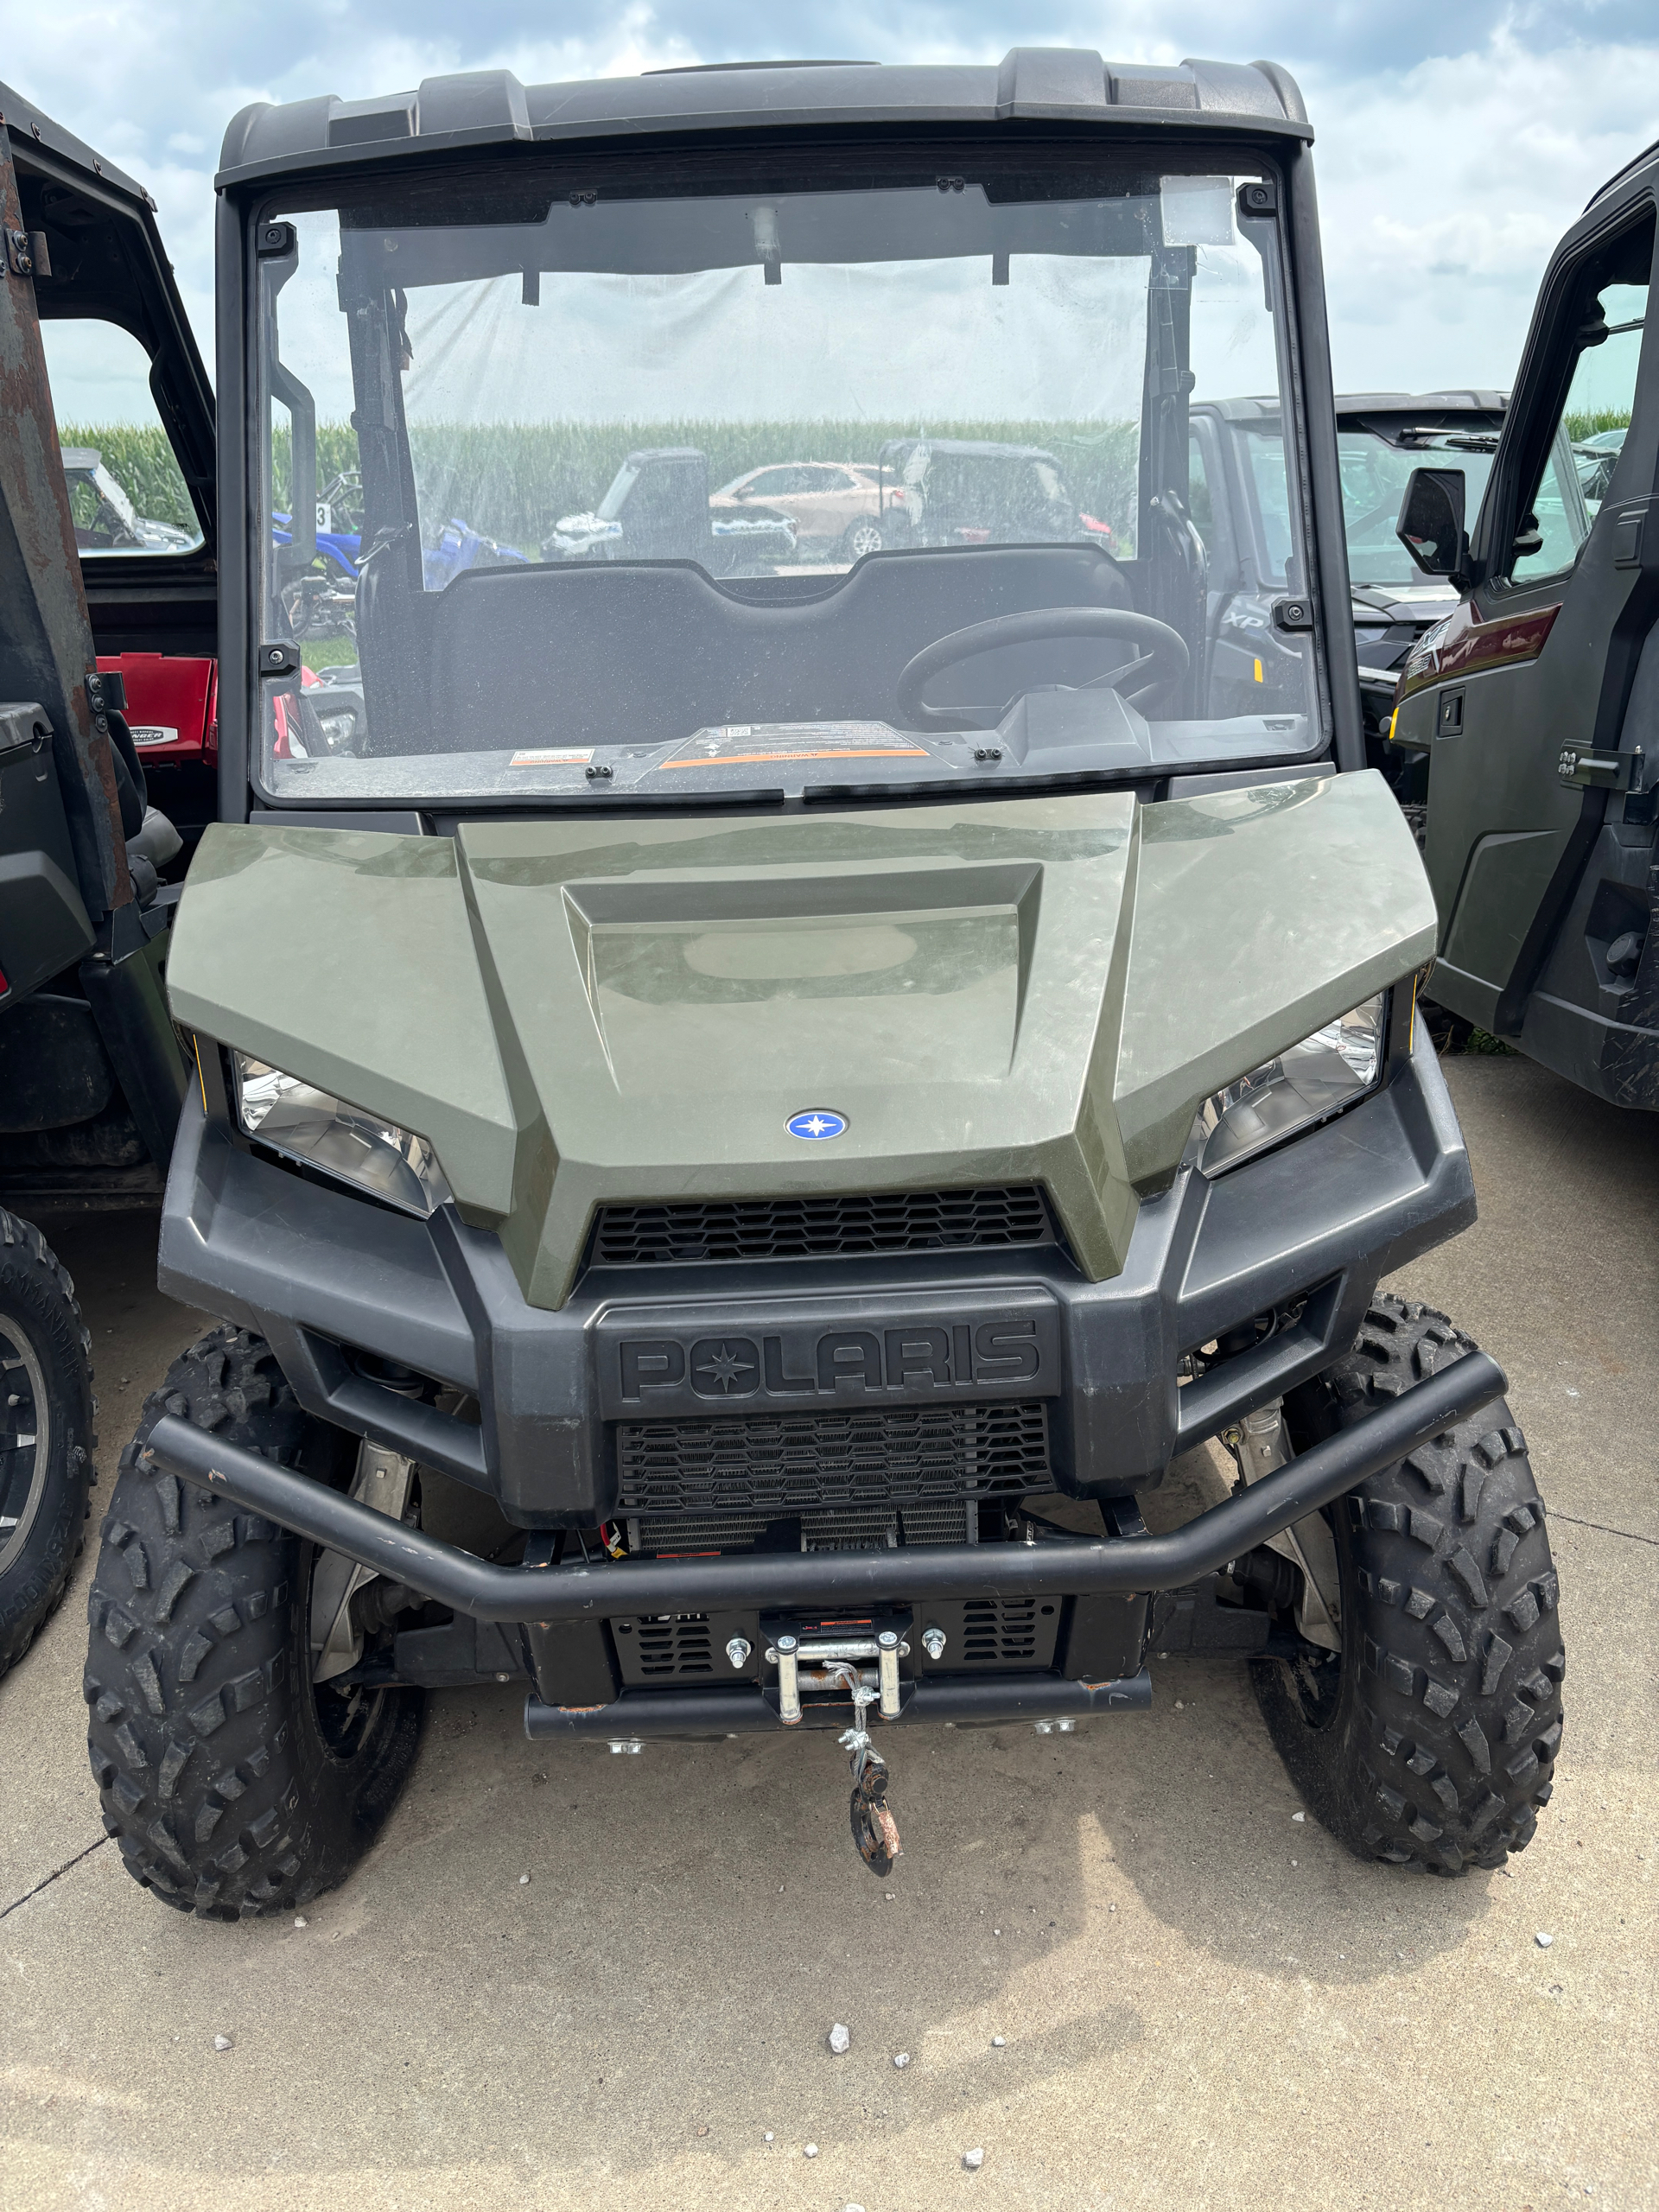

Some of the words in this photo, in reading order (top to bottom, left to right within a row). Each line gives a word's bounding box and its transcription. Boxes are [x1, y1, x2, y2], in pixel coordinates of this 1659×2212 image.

[317, 506, 326, 526] 3
[1221, 612, 1264, 629] XP
[619, 1319, 1039, 1403] POLARIS
